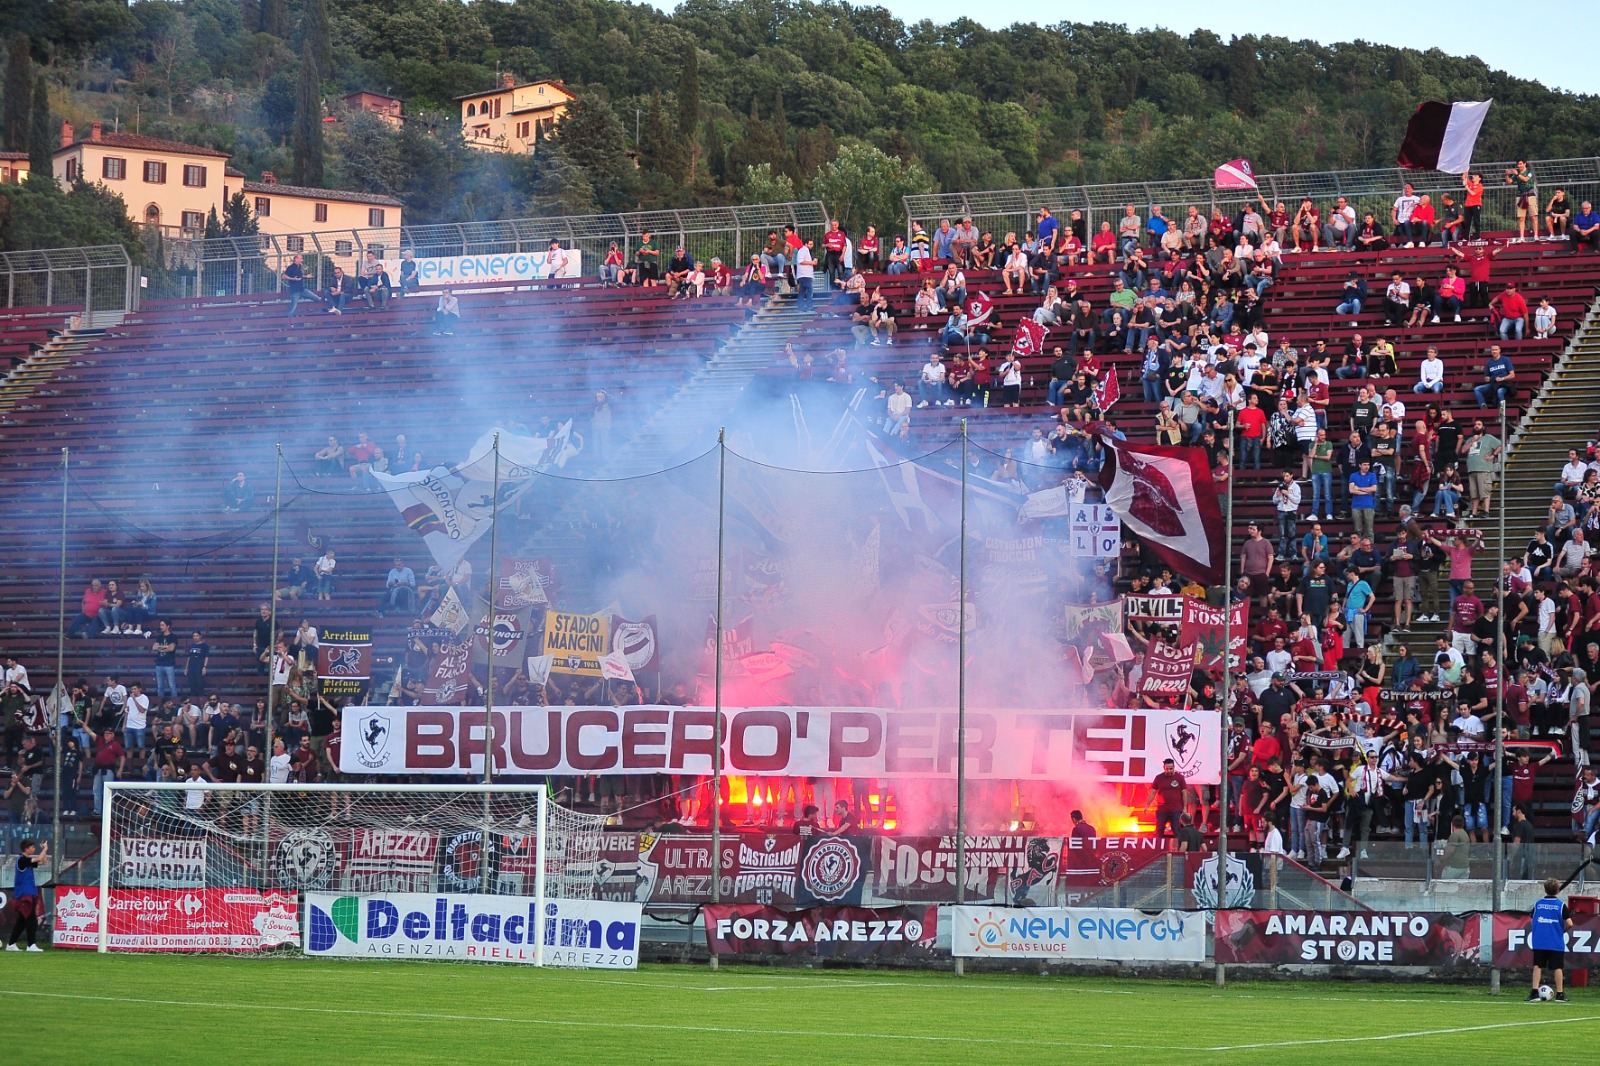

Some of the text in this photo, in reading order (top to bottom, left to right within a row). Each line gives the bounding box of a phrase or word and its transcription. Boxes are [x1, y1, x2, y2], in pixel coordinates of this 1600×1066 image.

[1128, 597, 1184, 618] DEVILS
[1188, 600, 1244, 613] codice eico
[480, 614, 517, 624] AEZZO
[555, 614, 599, 635] STADIO
[1187, 609, 1243, 626] FOSSA
[321, 629, 370, 641] Arretium
[547, 631, 604, 653] MANCINI
[492, 648, 508, 658] 923
[323, 687, 362, 695] presente
[405, 710, 1148, 777] BRUCERO' PER TE!
[1306, 736, 1355, 747] FORZA AREZZO
[121, 839, 204, 859] VECCHIA
[359, 829, 431, 858] AREZZO
[575, 835, 636, 852] POLVERE
[1068, 837, 1165, 851] ETERNI
[738, 842, 801, 867] CASTIGLION
[814, 845, 851, 861] TRADIZIONE
[121, 861, 204, 882] GUARDIA
[733, 874, 797, 899] FIBOCCHI
[69, 899, 85, 909] Bar
[108, 895, 171, 911] Carrefour
[136, 912, 169, 921] market
[186, 920, 229, 929] Superstore
[366, 898, 636, 951] Deltaclima
[717, 918, 812, 942] FORZA
[1265, 914, 1430, 937] AMARANTO
[59, 932, 92, 943] Orario:
[140, 936, 158, 946] alla
[161, 936, 206, 946] Domenica
[241, 937, 259, 947] 20.3
[367, 943, 456, 956] AGENZIA
[467, 945, 538, 960] RIELL
[1011, 943, 1067, 952] GAS E LUCE
[552, 951, 634, 966] AREZZO
